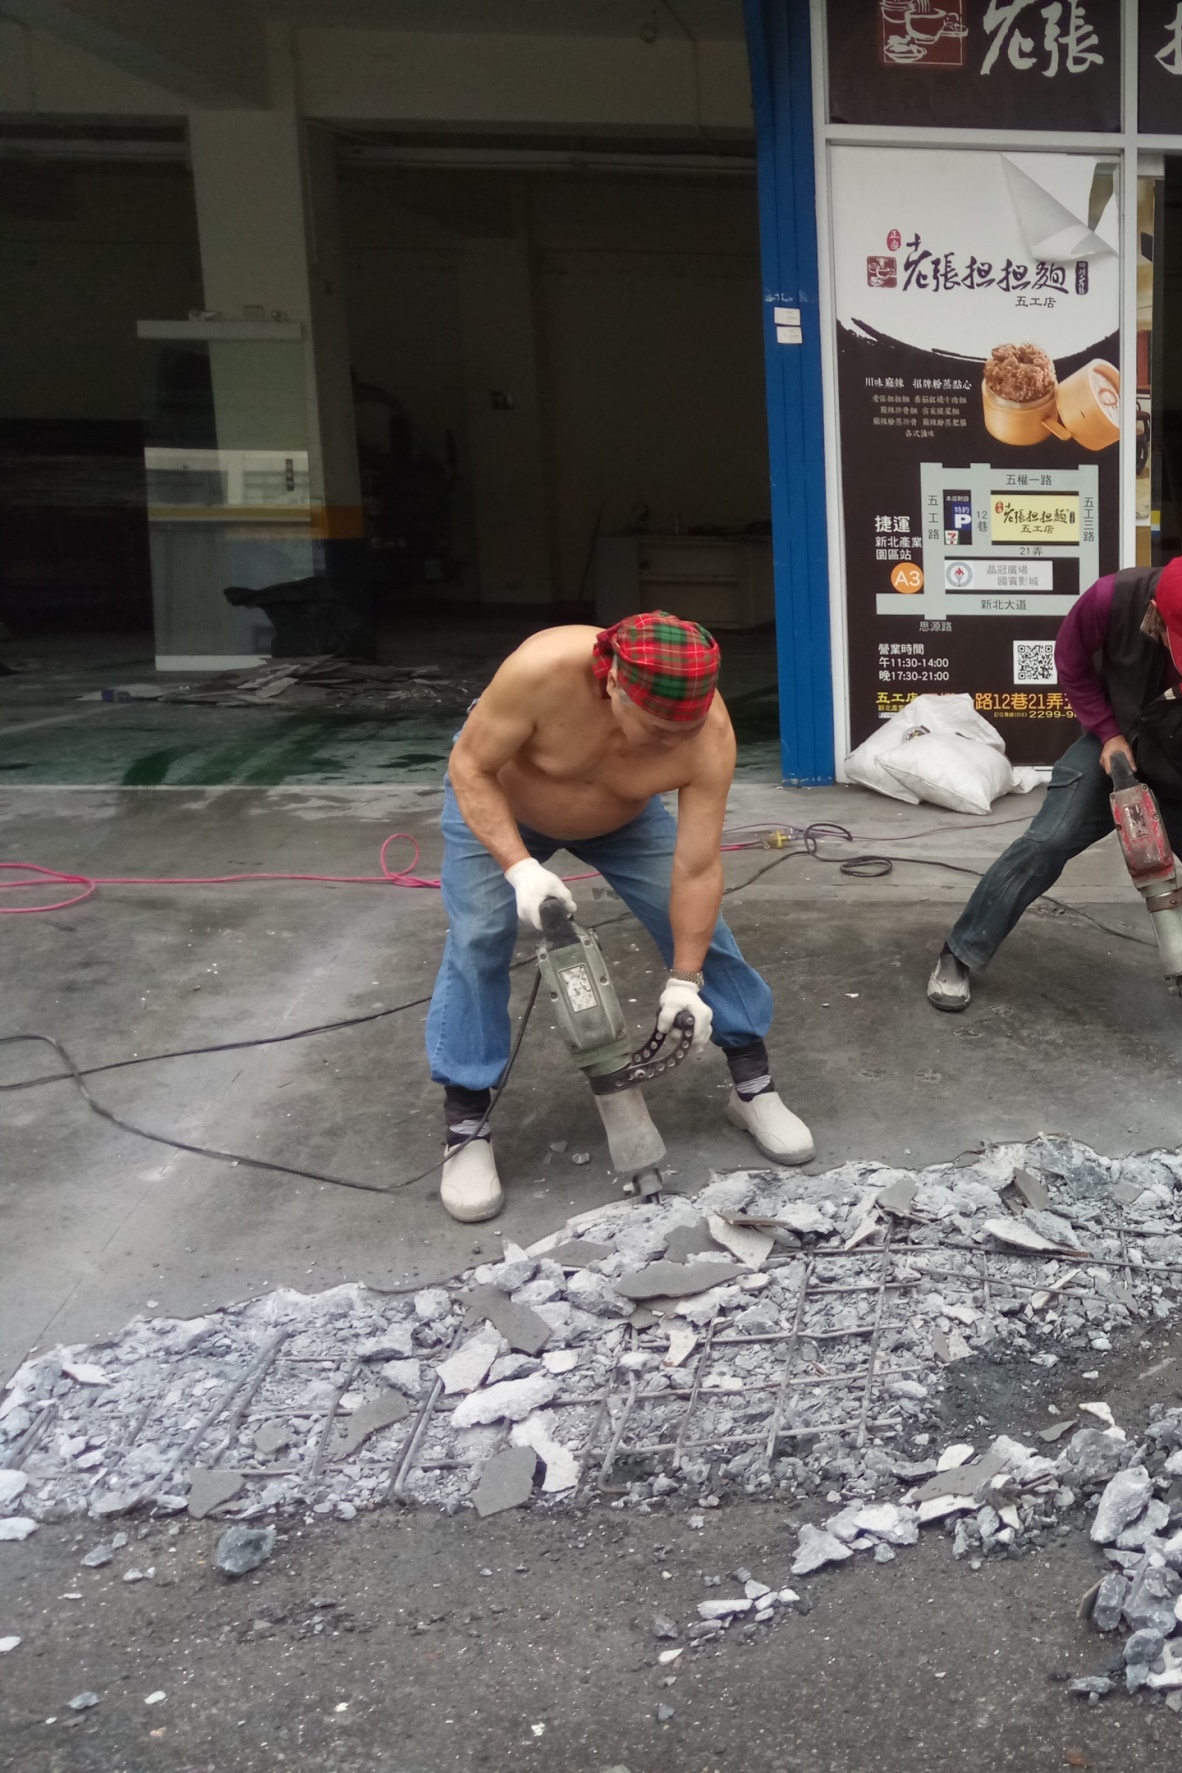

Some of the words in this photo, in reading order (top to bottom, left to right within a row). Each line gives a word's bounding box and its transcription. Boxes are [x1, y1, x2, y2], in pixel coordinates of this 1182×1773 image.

[901, 233, 1069, 294] 老張担担麵
[1015, 296, 1056, 308] 五工店
[1006, 474, 1052, 486] 五權一路
[954, 506, 970, 514] 特約
[976, 511, 988, 520] 12
[928, 495, 939, 540] 五工路
[954, 514, 972, 529] P
[1083, 497, 1095, 542] 五工三路
[875, 515, 910, 533] 捷運
[977, 521, 989, 532] 巷
[1021, 524, 1054, 534] 五工店
[875, 536, 922, 548] 新北產業
[876, 549, 912, 560] 園區站
[894, 570, 921, 586] A3
[981, 600, 1027, 610] 新北大道
[919, 621, 952, 632] 思源路
[878, 643, 925, 655] 營業時間
[879, 657, 949, 669] 午11:30-14:00
[879, 671, 949, 682] 晚17:30-21:00
[1029, 710, 1077, 719] 2299-9
